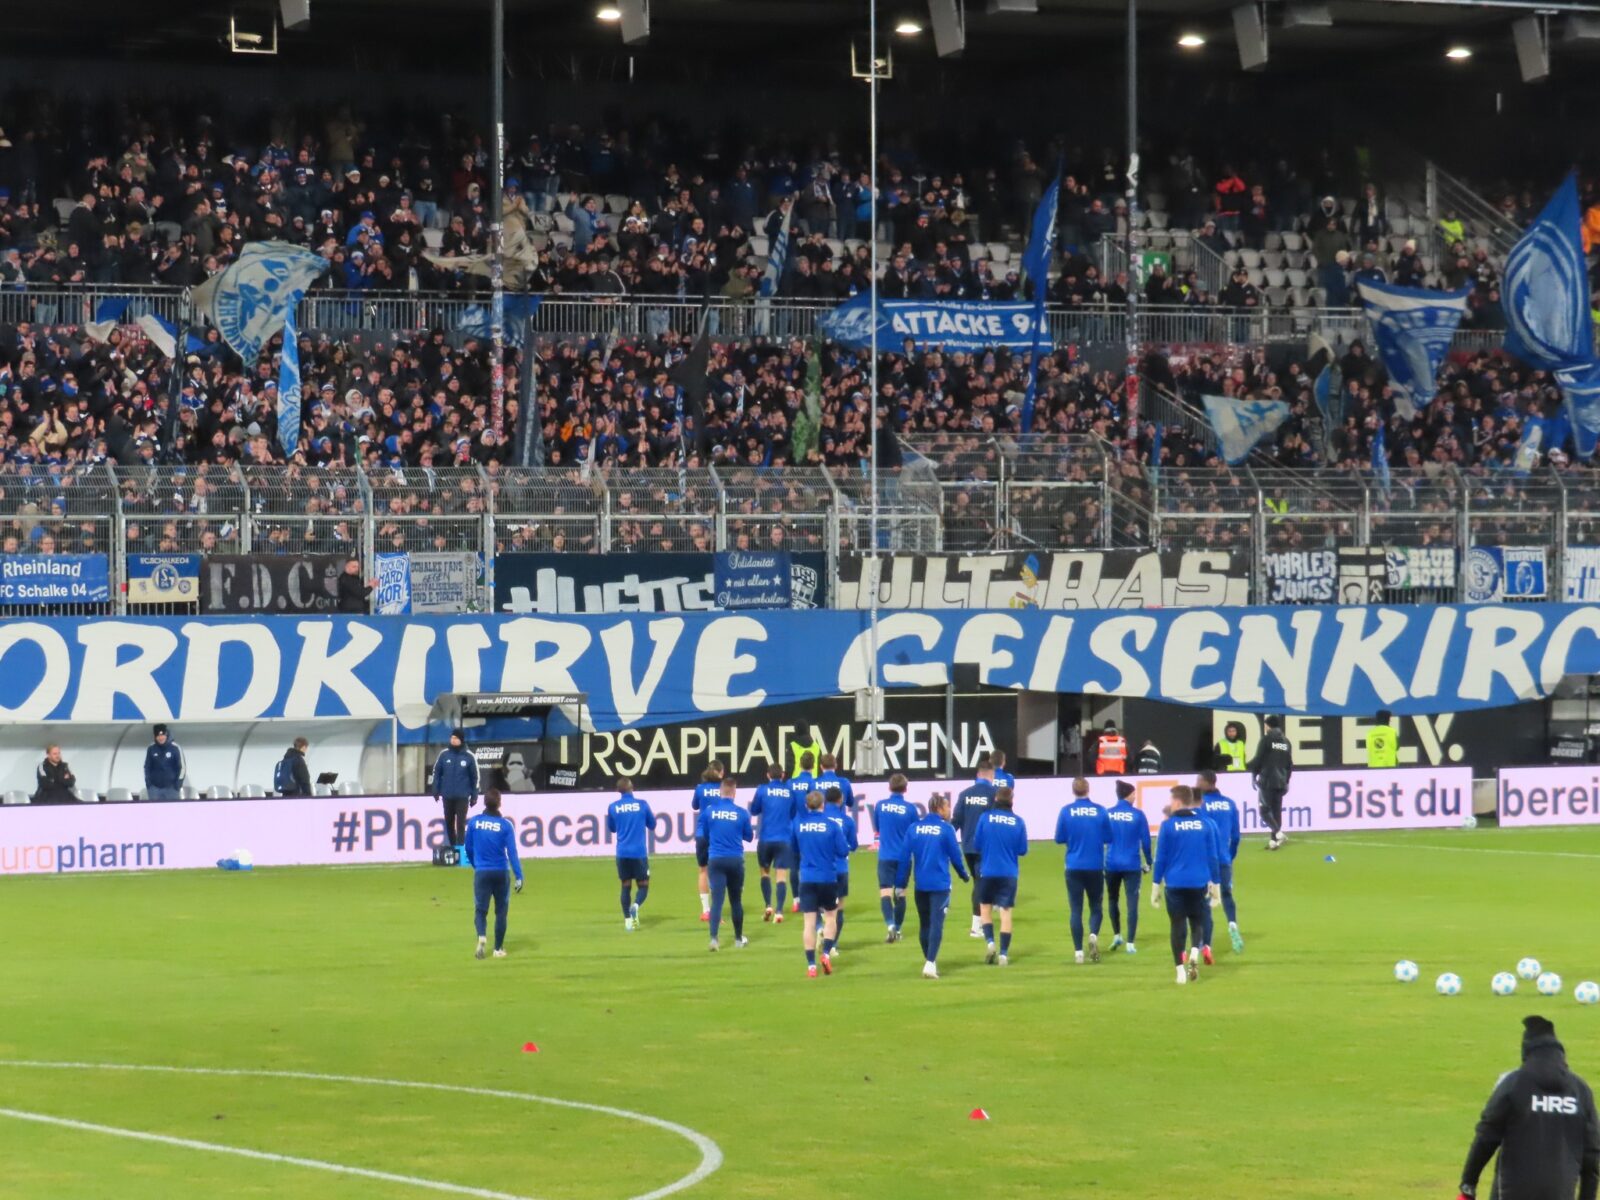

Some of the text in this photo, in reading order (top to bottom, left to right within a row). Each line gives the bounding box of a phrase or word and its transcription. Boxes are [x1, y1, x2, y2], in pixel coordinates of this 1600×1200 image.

[892, 310, 1004, 336] ATTACKE
[3, 559, 82, 578] Rheinland
[1263, 551, 1337, 579] MARLER
[379, 570, 403, 587] HARD
[17, 584, 69, 599] Schalke
[71, 583, 87, 597] 04
[377, 584, 402, 605] KOR
[1272, 578, 1334, 600] JUNGS
[1272, 741, 1288, 751] HRS
[550, 775, 577, 787] DECKERT
[792, 782, 809, 791] HR
[991, 778, 1007, 788] RS
[704, 788, 721, 797] HR
[767, 787, 791, 798] HRS
[965, 796, 988, 806] HRS
[1328, 780, 1404, 819] Bist
[1413, 778, 1462, 818] du
[615, 803, 641, 814] HRS
[881, 803, 906, 815] HRS
[1205, 801, 1231, 811] HRS
[711, 810, 738, 821] HRS
[1070, 807, 1098, 817] HRS
[1108, 812, 1133, 822] HRS
[989, 814, 1016, 826] HRS
[1174, 820, 1203, 831] HRS
[475, 820, 501, 832] HRS
[800, 822, 827, 833] HRS
[916, 825, 941, 836] HRS
[1531, 1094, 1578, 1115] HRS
